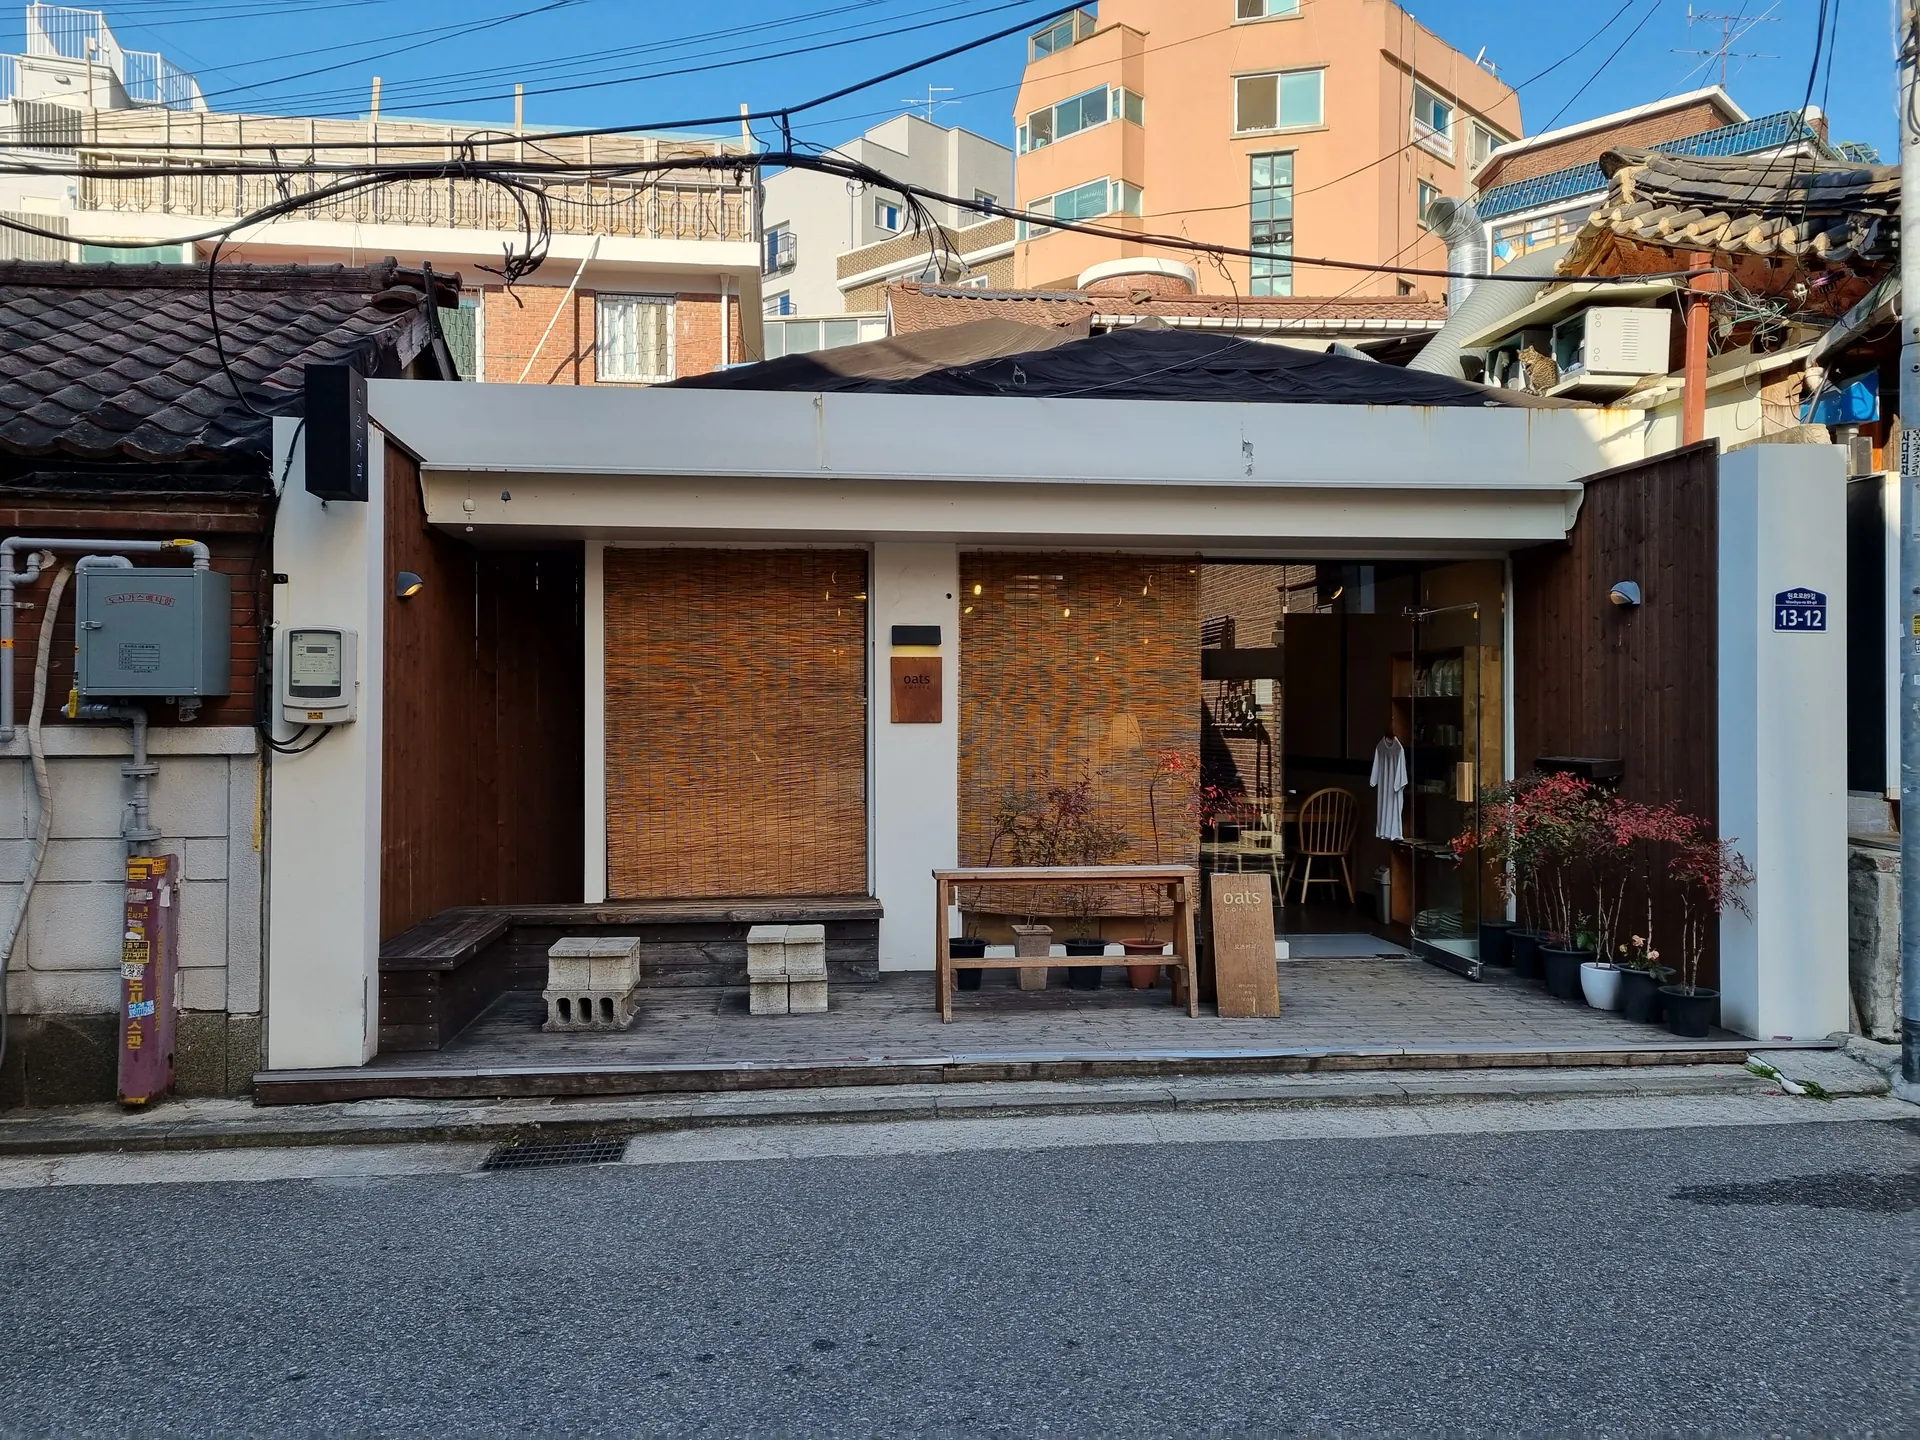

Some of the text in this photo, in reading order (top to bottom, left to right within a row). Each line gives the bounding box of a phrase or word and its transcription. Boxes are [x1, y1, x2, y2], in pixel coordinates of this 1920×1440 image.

[1780, 609, 1822, 627] 13-12
[904, 674, 930, 684] oats
[1223, 890, 1261, 905] oats
[126, 980, 144, 1050] 도시스관
